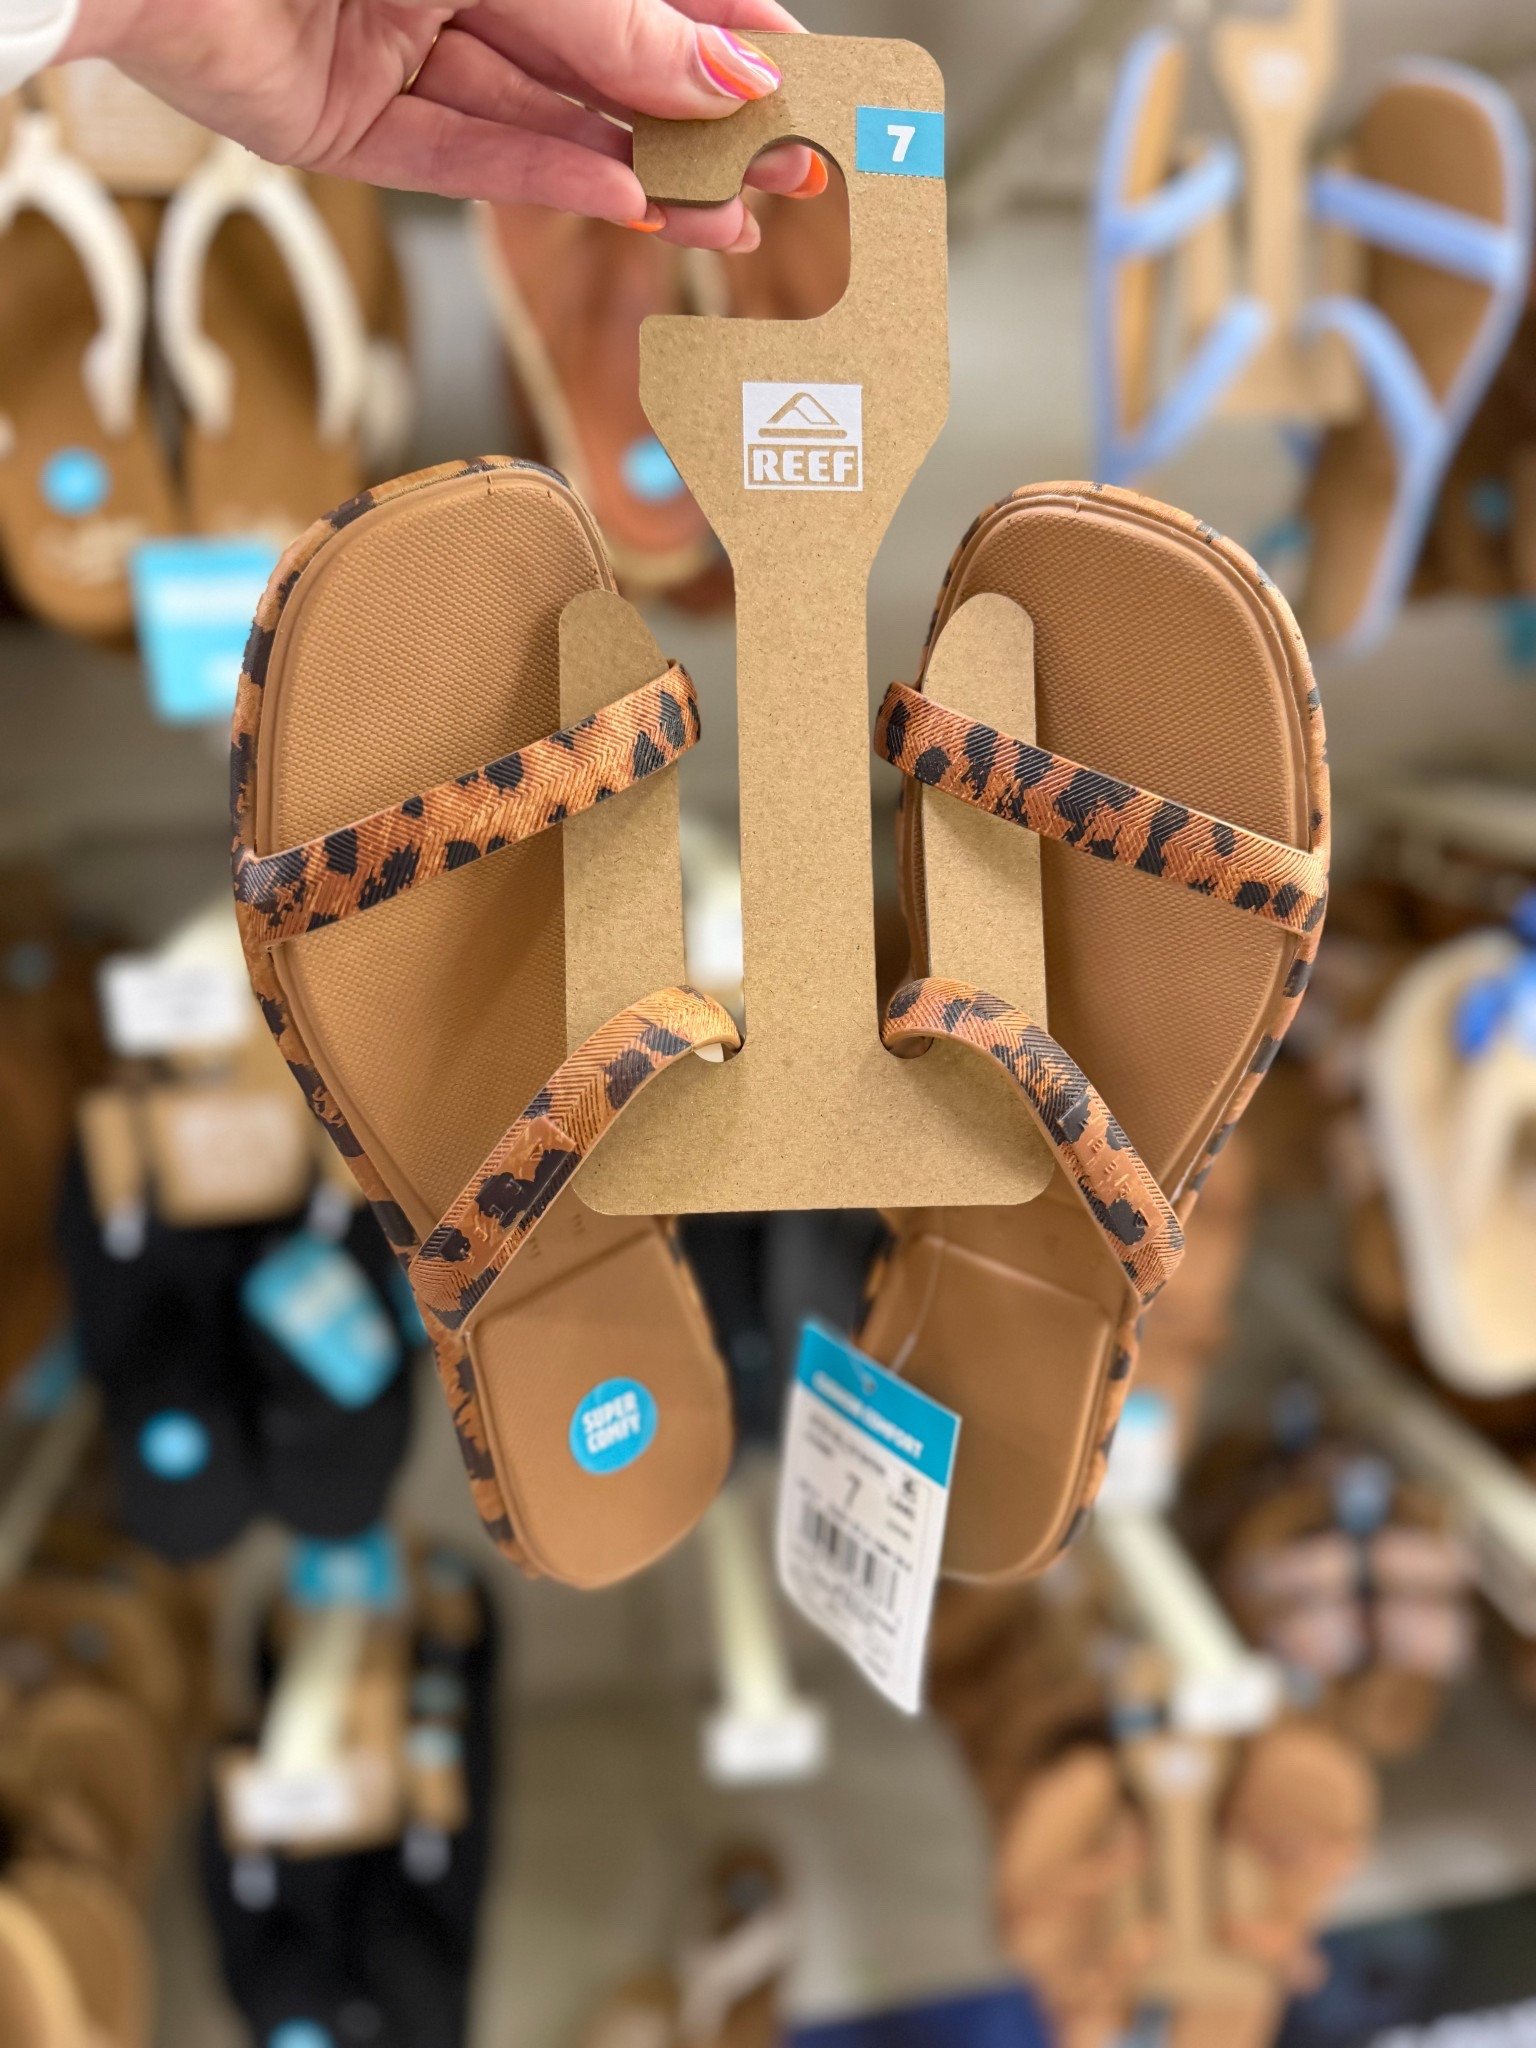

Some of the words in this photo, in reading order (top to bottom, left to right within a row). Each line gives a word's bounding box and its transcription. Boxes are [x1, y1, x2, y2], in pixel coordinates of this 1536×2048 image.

[887, 124, 916, 162] 7
[752, 448, 855, 483] REEF
[582, 1390, 638, 1434] SUPER
[587, 1412, 641, 1454] COMFY
[845, 1472, 862, 1508] 7
